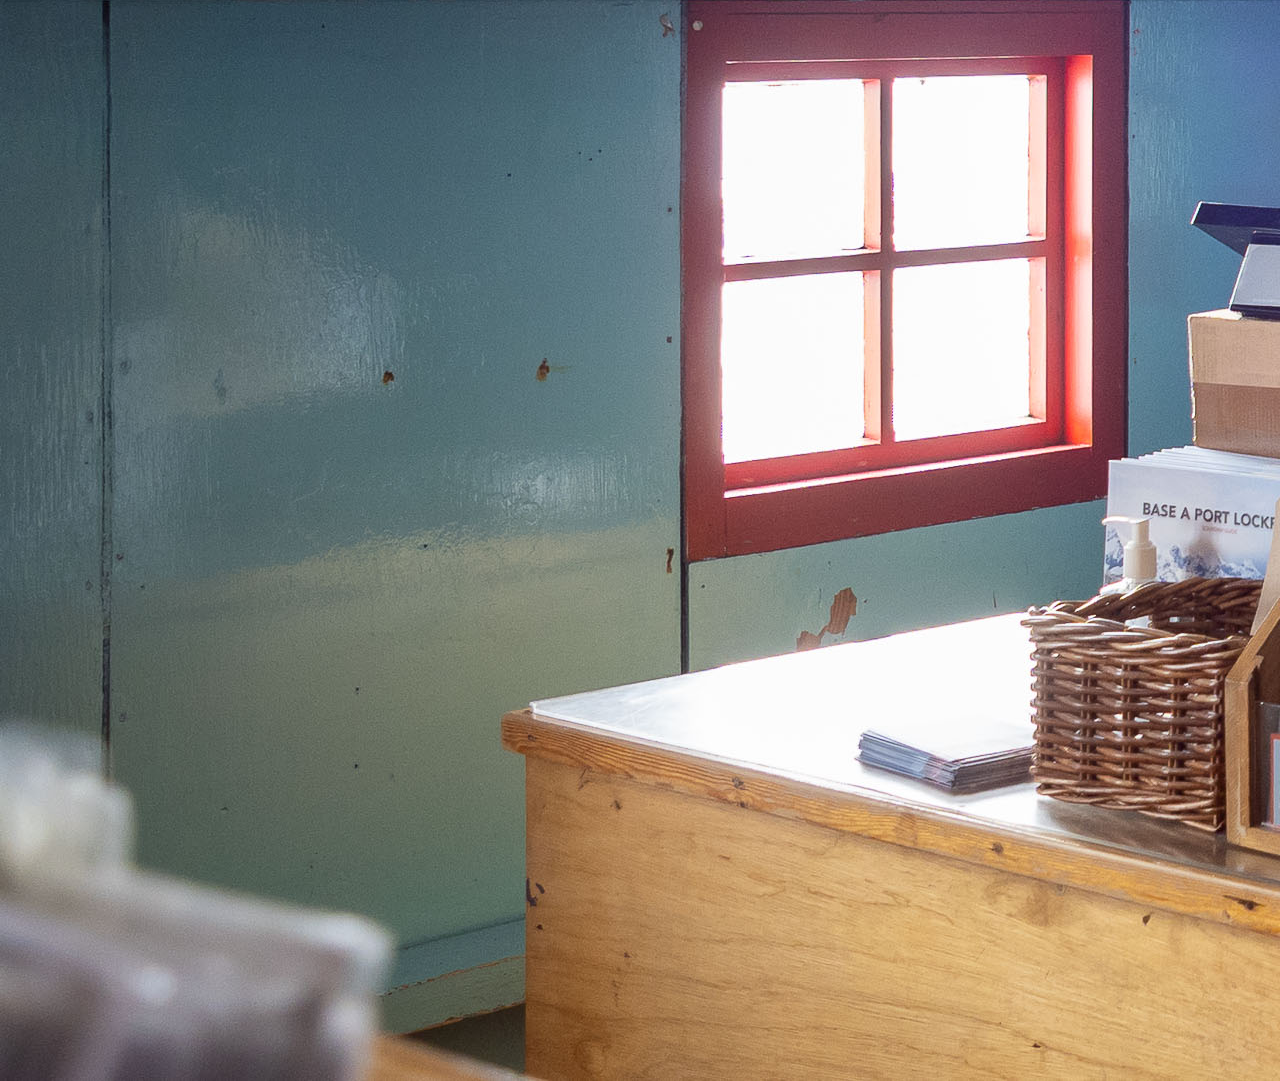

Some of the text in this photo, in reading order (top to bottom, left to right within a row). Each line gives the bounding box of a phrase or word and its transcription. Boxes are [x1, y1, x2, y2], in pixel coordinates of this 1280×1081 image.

[1143, 502, 1176, 518] BASE
[1180, 507, 1191, 520] A
[1194, 508, 1230, 525] PORT
